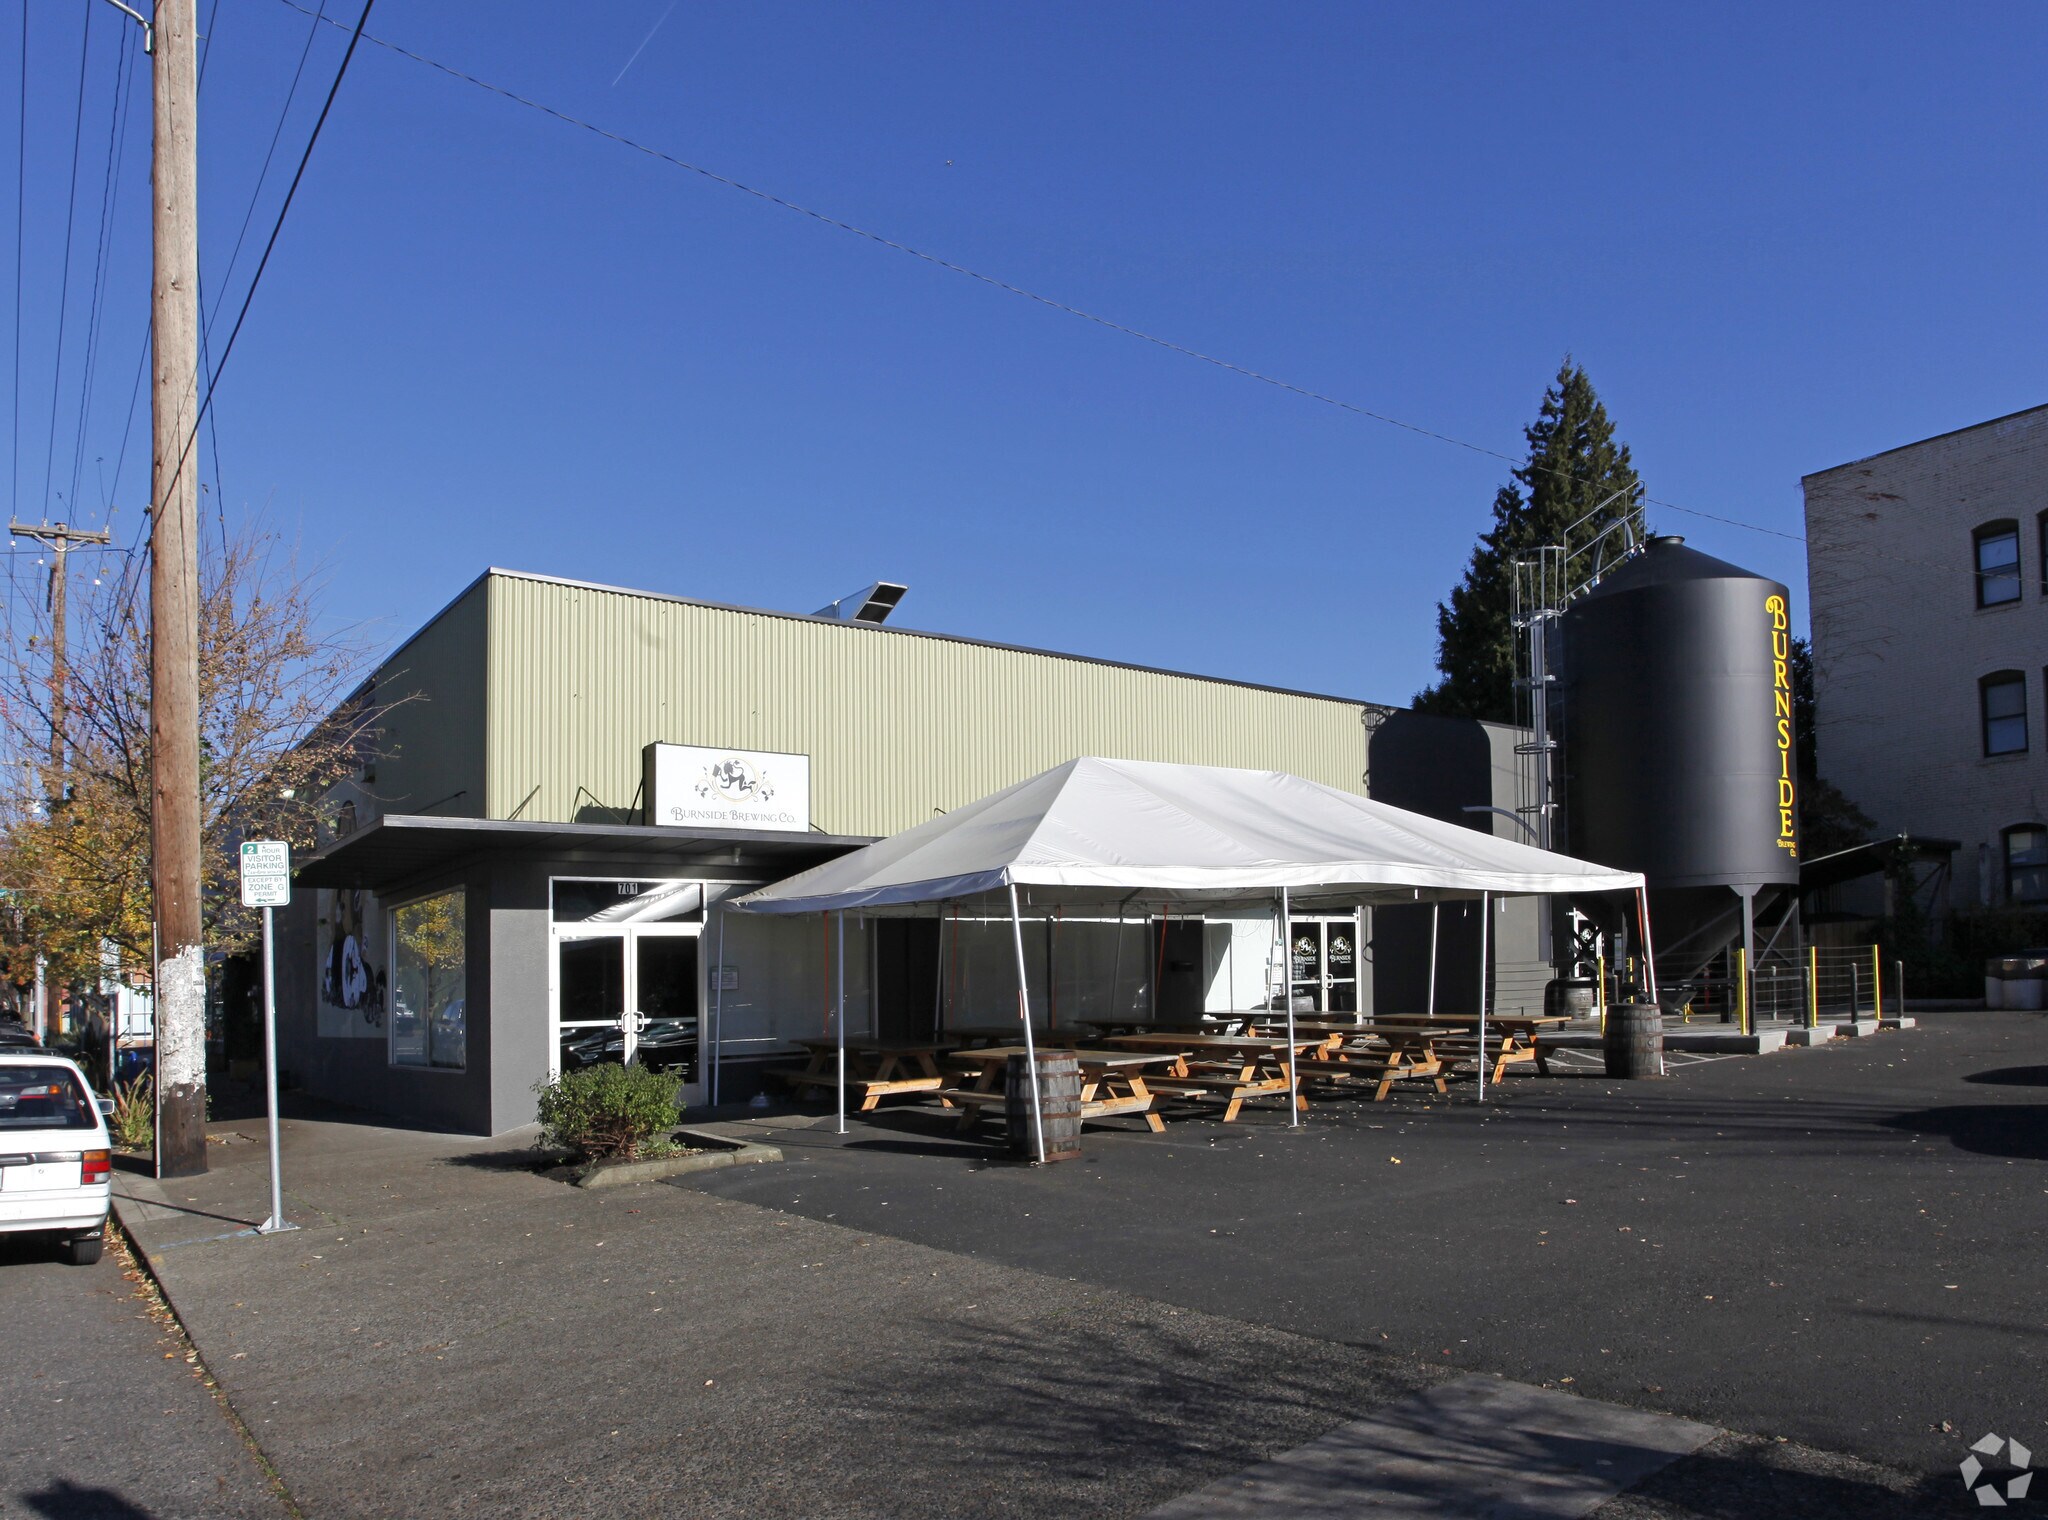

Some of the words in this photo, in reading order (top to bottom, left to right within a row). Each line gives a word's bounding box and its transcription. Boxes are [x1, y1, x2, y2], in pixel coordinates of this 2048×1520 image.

[1766, 595, 1794, 837] BURNSIDE
[671, 807, 728, 821] BURNSIDE
[729, 810, 778, 822] BREWING
[247, 846, 254, 854] 2
[618, 883, 637, 894] 701
